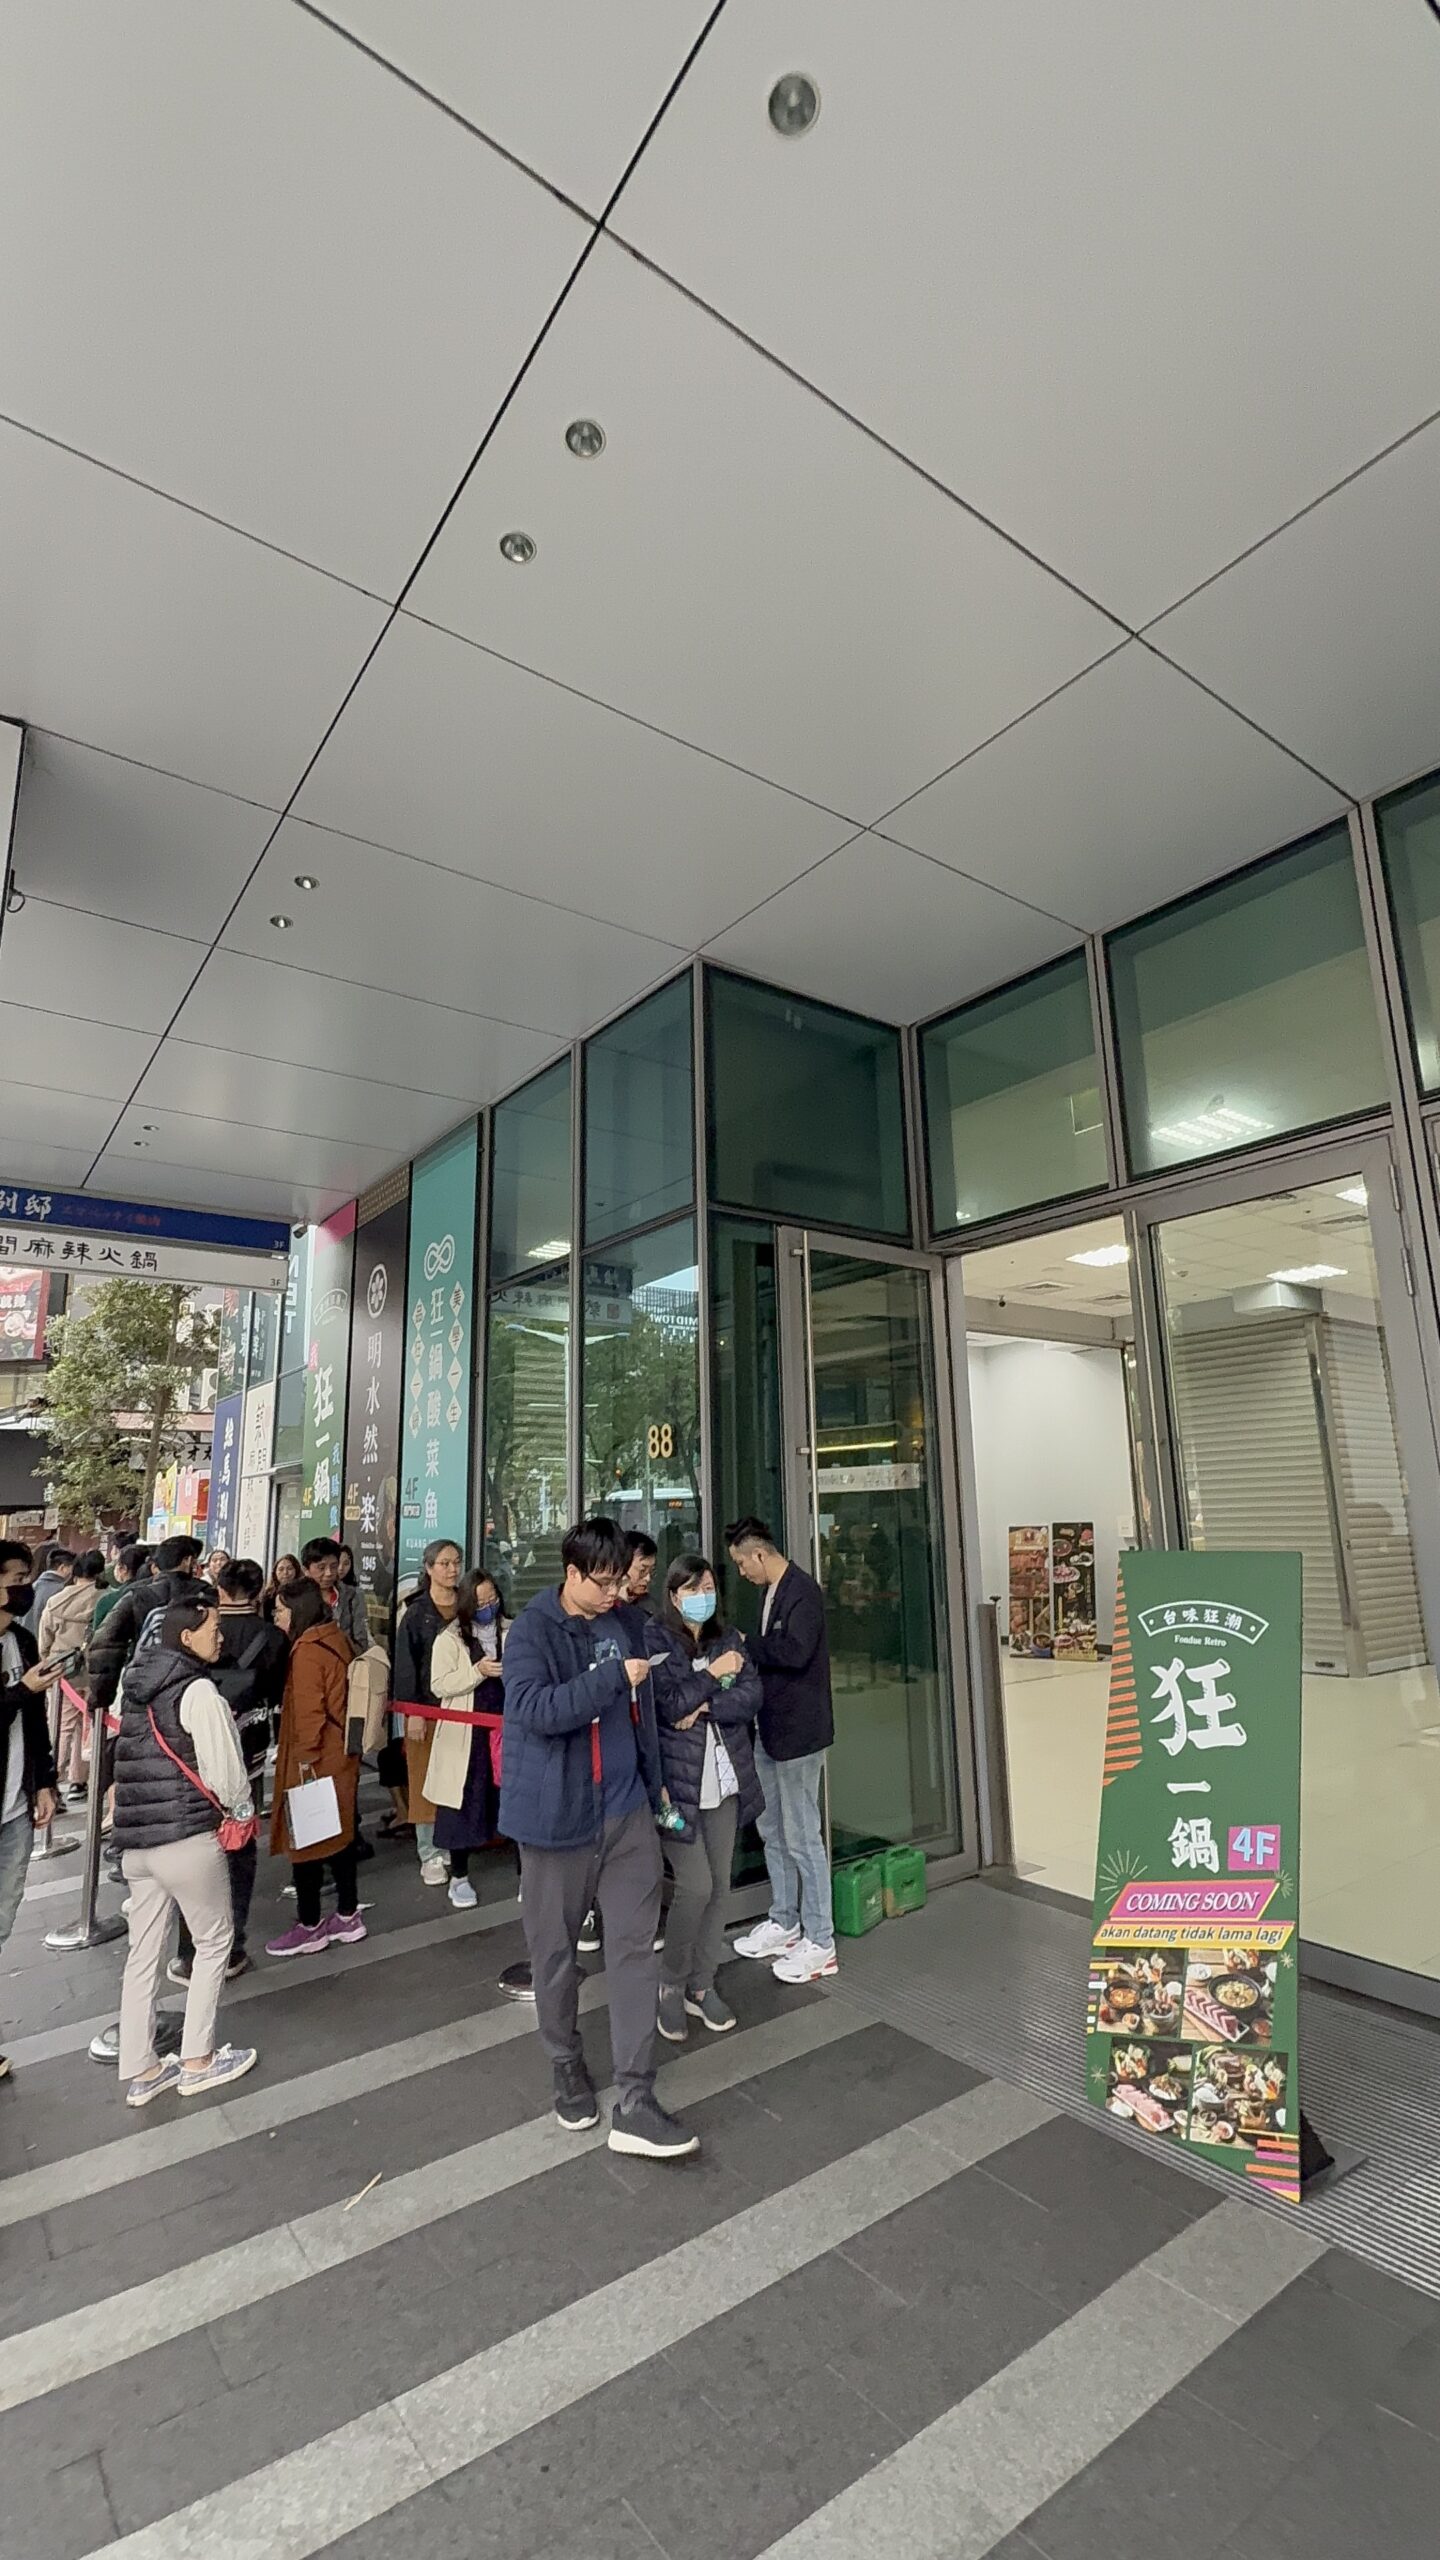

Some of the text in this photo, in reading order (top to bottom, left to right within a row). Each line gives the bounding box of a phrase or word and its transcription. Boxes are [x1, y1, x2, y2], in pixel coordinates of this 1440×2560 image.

[273, 1240, 285, 1249] 3F
[270, 1278, 281, 1286] 3F
[312, 1364, 333, 1507] 狂一鍋
[648, 1423, 673, 1459] 88
[302, 1486, 313, 1507] 4F
[347, 1483, 359, 1504] 4F
[405, 1476, 419, 1501] 4F
[361, 1555, 377, 1572] 1945
[1163, 1608, 1242, 1631] 台味狂潮
[1174, 1634, 1227, 1648] Fondue Retro
[1149, 1656, 1248, 1874] 狂一鍋
[1232, 1826, 1276, 1866] 4F
[1126, 1891, 1259, 1912] COMING SOON
[1100, 1926, 1284, 1944] akan datang tidak lama lagi
